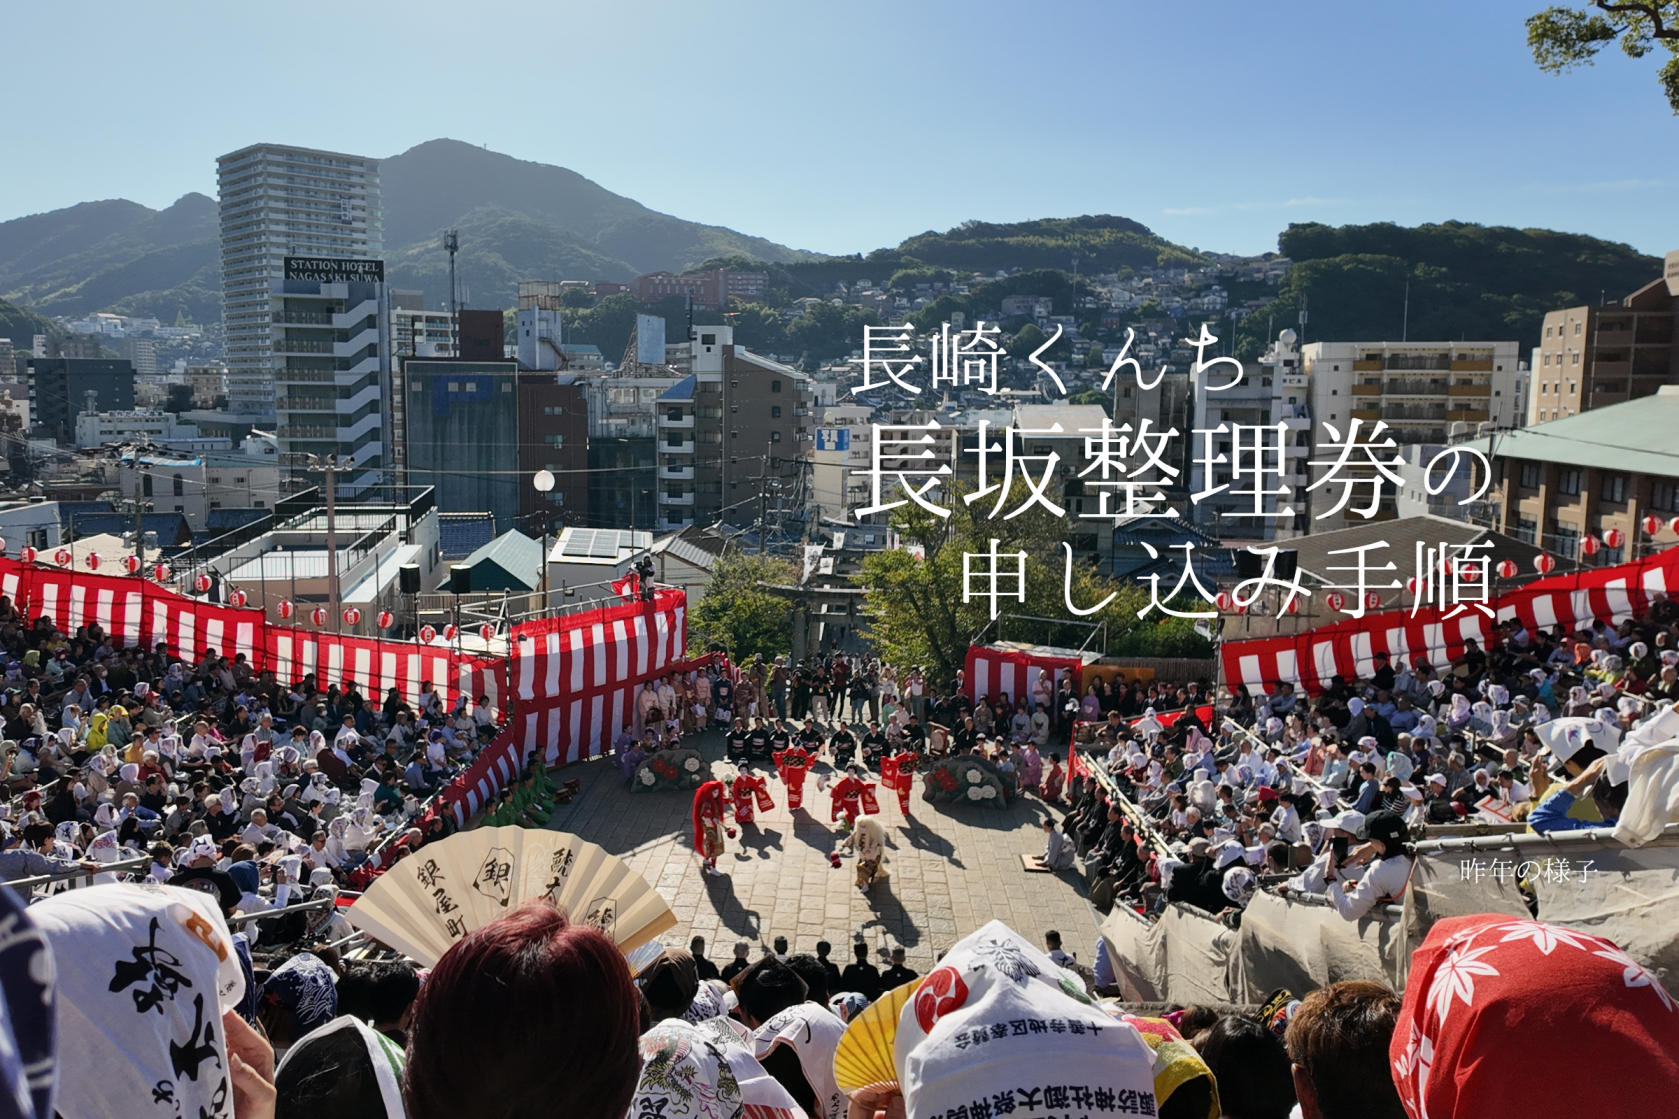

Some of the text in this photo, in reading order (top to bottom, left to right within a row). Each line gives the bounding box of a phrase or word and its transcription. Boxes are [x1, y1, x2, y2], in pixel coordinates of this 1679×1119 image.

[289, 271, 380, 283] NAGASAKI SUWA
[290, 259, 379, 272] STATION HOTEL
[433, 375, 494, 416] P
[482, 857, 511, 892] 銀
[416, 858, 468, 939] 銀屋町
[954, 1018, 1103, 1050] 十善寺地区奉賛会
[930, 1085, 1156, 1119] 諏訪神社御大祭神輿
